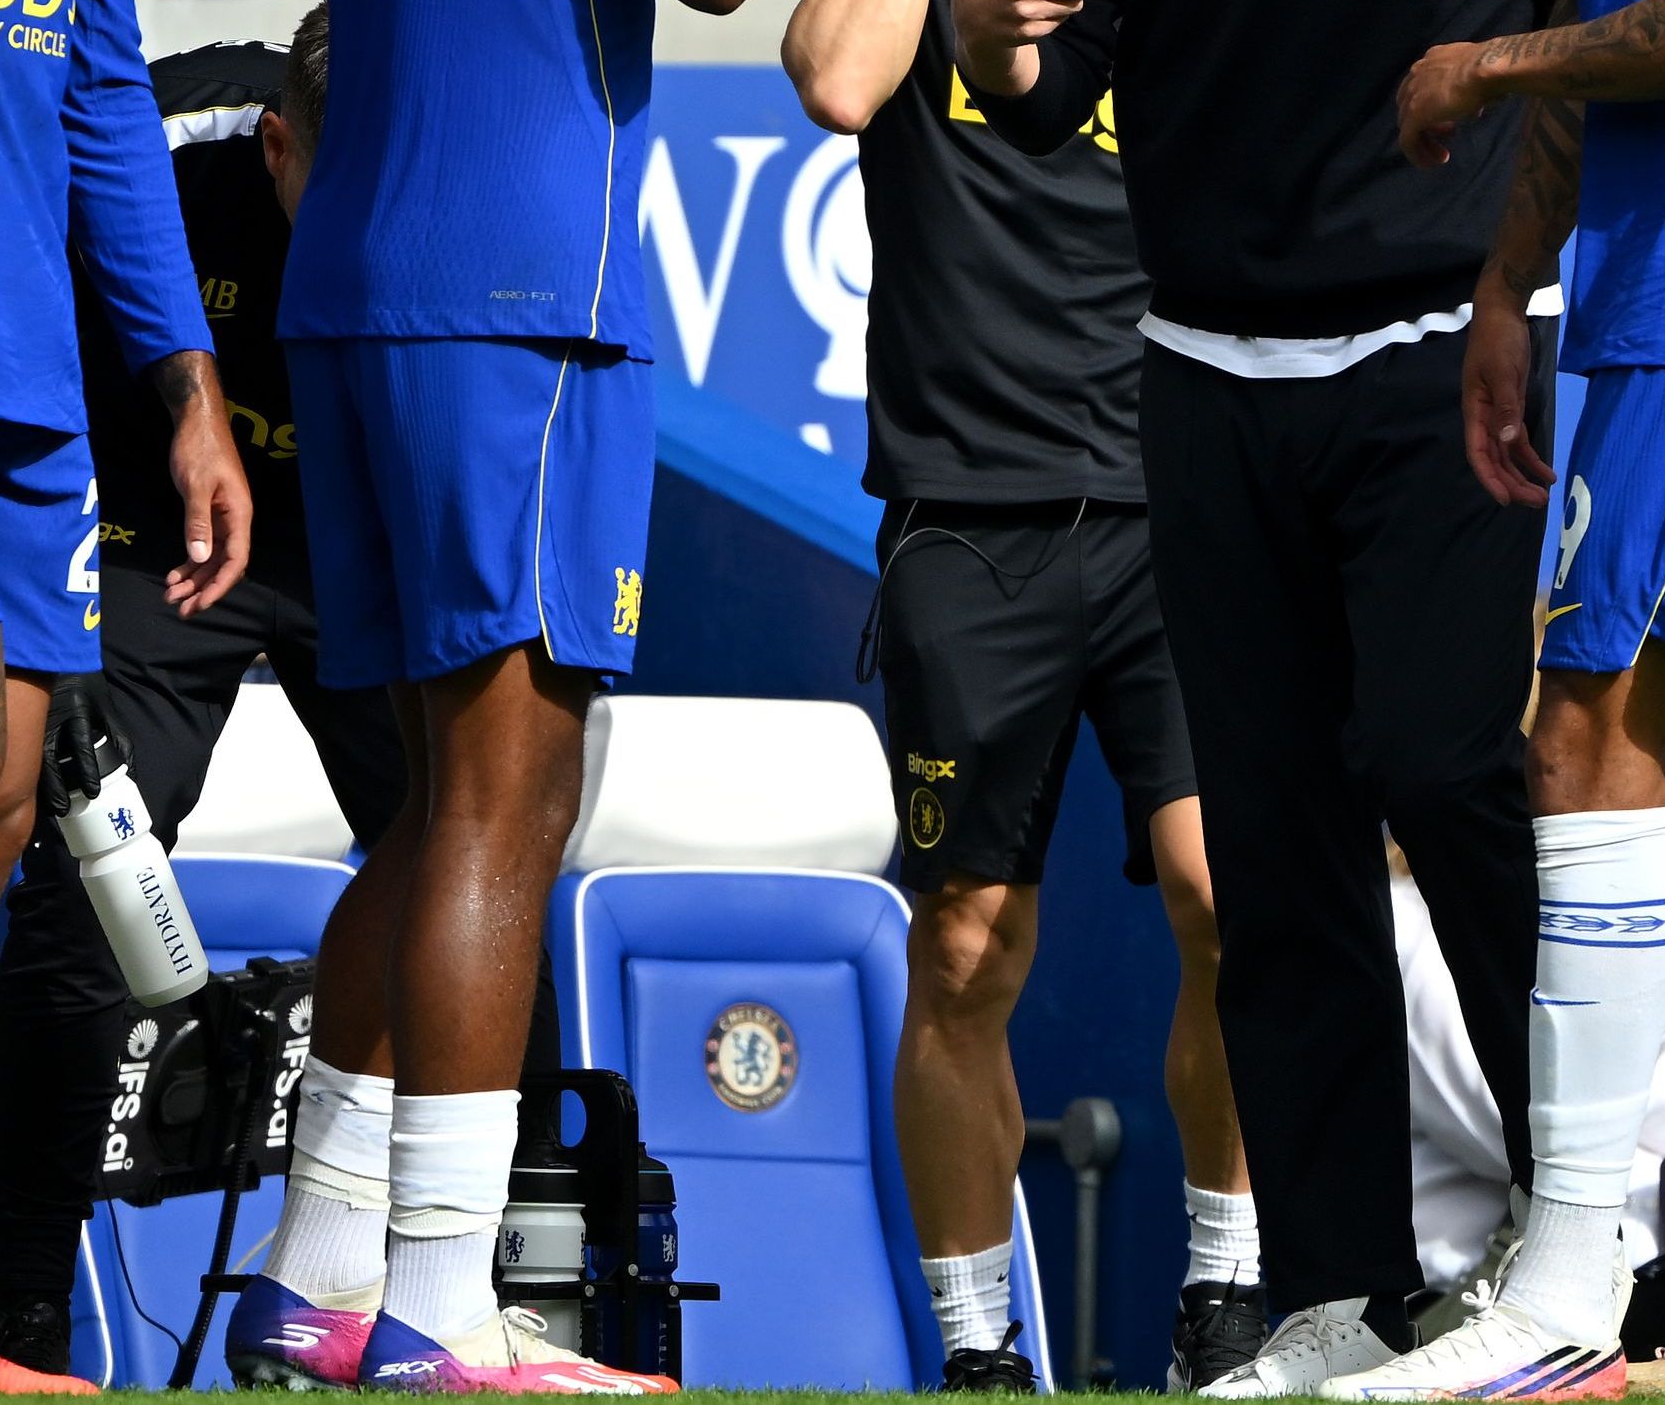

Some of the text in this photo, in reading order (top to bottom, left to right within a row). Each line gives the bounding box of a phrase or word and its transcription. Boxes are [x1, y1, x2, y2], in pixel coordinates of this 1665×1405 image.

[7, 23, 67, 58] CIRCLE
[489, 290, 557, 303] AERO-FIT
[136, 866, 193, 975] HYDRATE
[102, 1061, 150, 1173] IFS.ai
[374, 1359, 445, 1378] SKX
